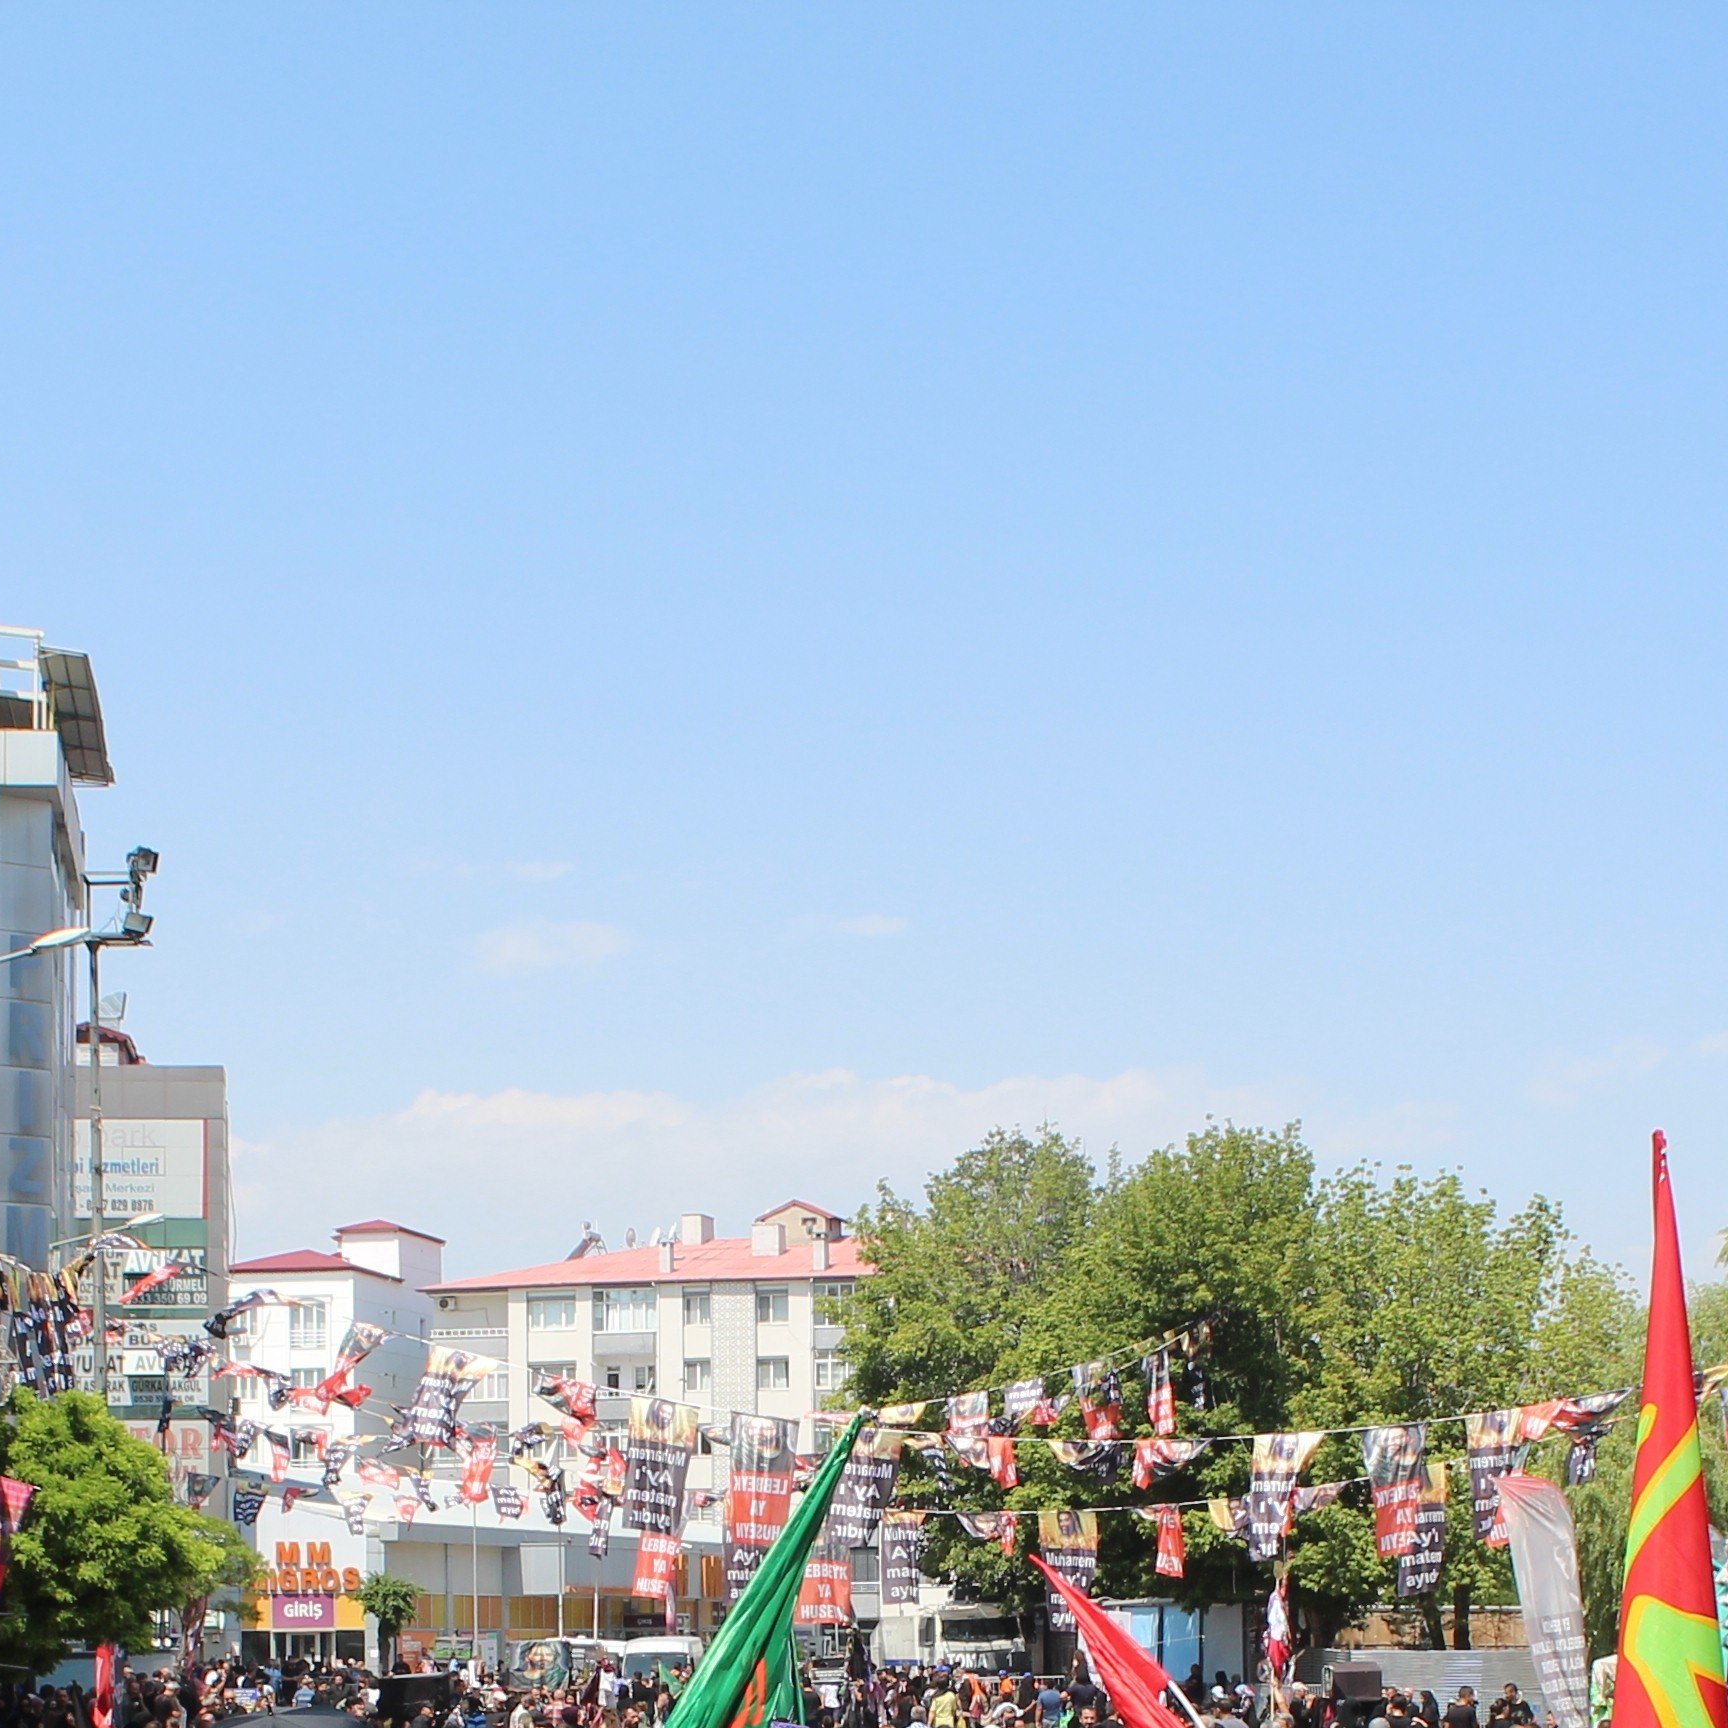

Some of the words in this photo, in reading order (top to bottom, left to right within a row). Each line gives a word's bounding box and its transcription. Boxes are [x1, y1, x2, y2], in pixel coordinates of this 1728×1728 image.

[89, 1157, 160, 1175] zmetleri
[124, 1249, 206, 1275] AVUKAT
[177, 1292, 191, 1305] 69
[653, 1558, 667, 1574] YA
[803, 1562, 849, 1581] EBBEYK
[817, 1584, 833, 1599] YA
[283, 1603, 323, 1620] GİRİŞ
[946, 1652, 989, 1669] TOMA
